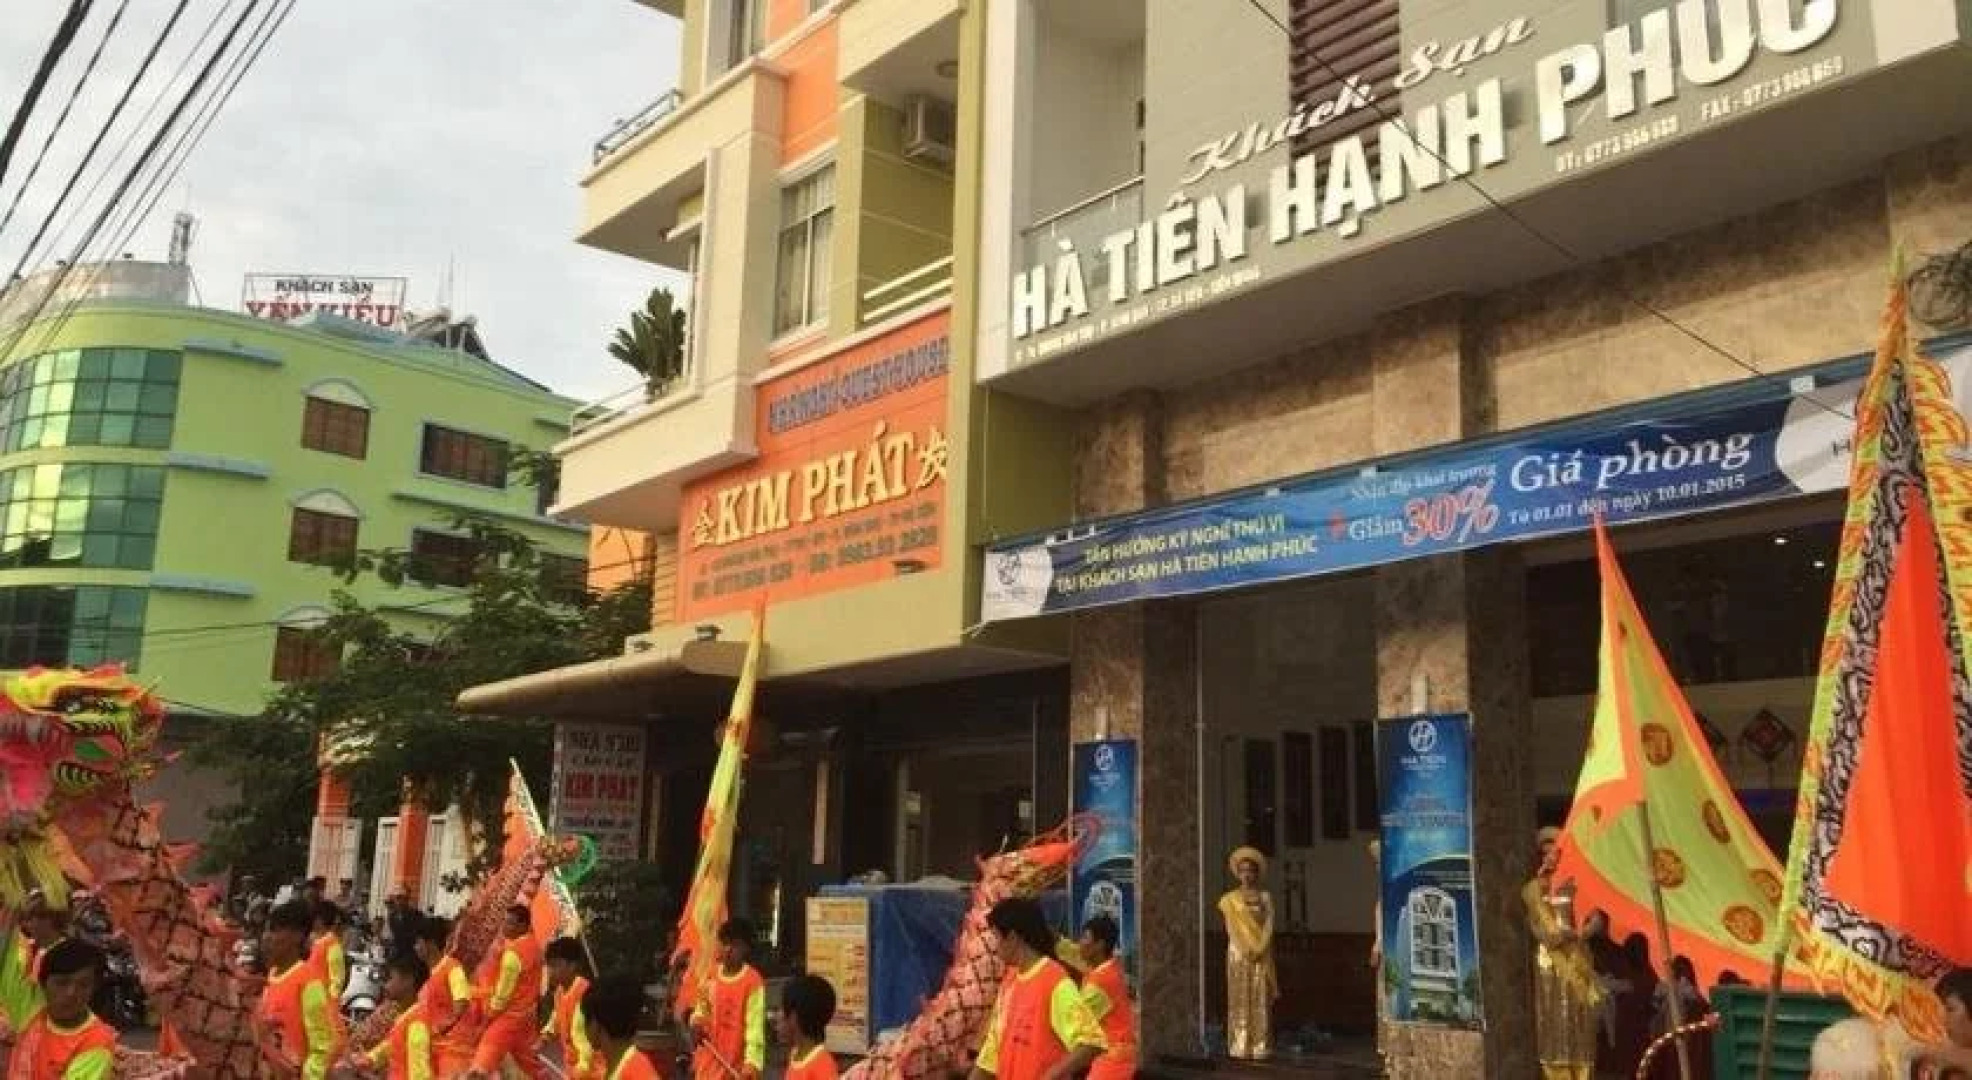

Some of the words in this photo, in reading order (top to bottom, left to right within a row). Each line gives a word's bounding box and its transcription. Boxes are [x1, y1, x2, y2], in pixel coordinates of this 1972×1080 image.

[1182, 75, 1375, 186] Khách
[1394, 14, 1538, 84] Sạn
[1012, 237, 1090, 340] HÀ
[1102, 184, 1248, 304] TIÊN
[1269, 76, 1506, 244] HẠNH
[716, 470, 793, 546] KIM
[799, 418, 916, 523] PHÁT
[1511, 447, 1584, 492] Giá
[1596, 432, 1755, 490] phòng
[1532, 503, 1572, 522] 01.01
[1656, 474, 1746, 502] 10.01.2015
[1403, 478, 1500, 546] 30%
